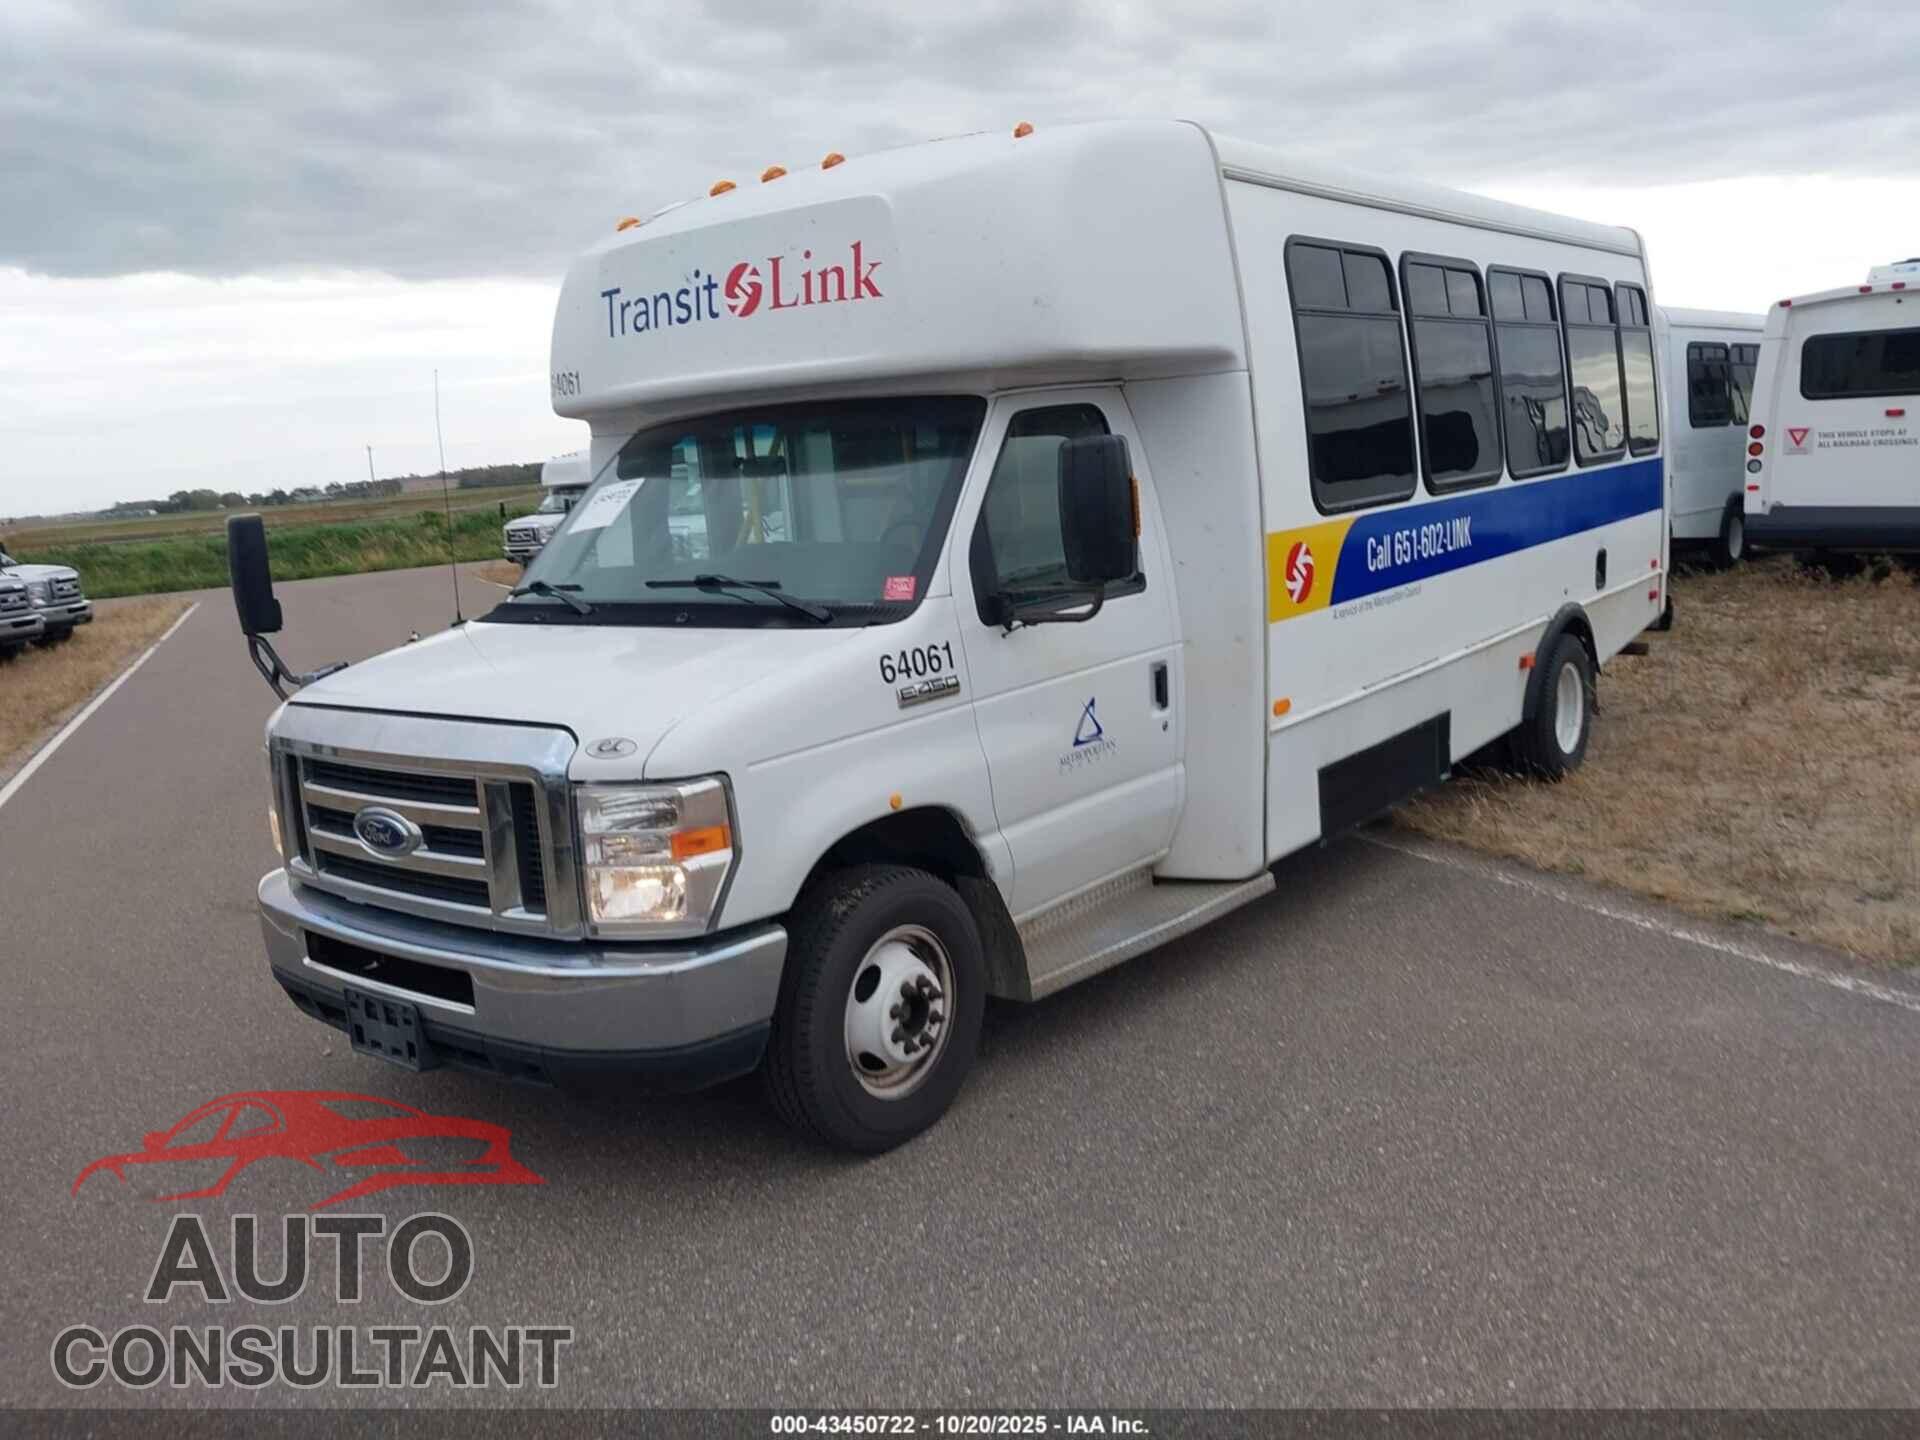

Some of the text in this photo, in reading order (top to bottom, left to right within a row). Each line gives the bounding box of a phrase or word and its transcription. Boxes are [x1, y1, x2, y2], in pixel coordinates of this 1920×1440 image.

[601, 240, 885, 338] Transit Link
[1817, 440, 1831, 448] ALL
[1833, 439, 1870, 448] RAILROAD
[1871, 429, 1895, 437] STOPS
[1367, 516, 1473, 573] Call 651-602-LINK
[880, 640, 954, 684] 64061
[364, 819, 392, 845] Ford
